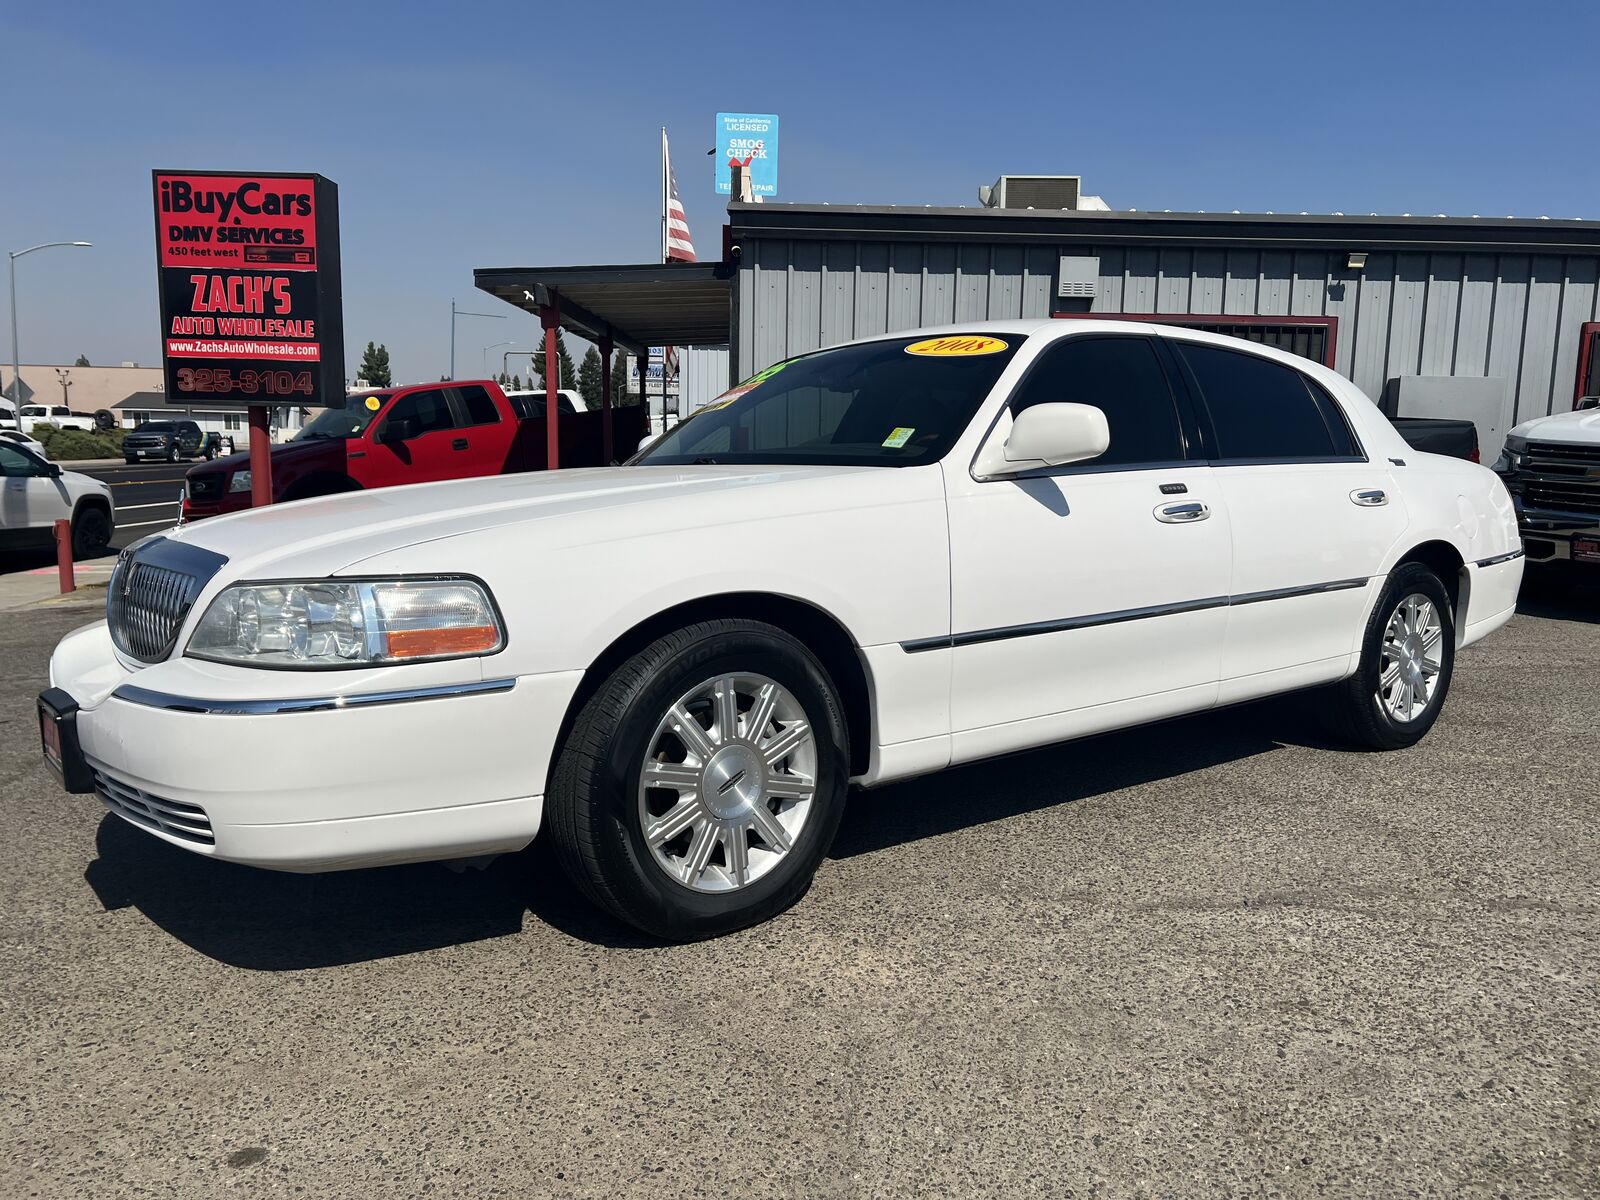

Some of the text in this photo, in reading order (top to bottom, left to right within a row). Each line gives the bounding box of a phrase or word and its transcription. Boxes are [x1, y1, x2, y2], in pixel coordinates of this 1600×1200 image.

[726, 123, 769, 132] LICENSED
[729, 139, 765, 149] SMOG
[726, 148, 768, 159] CHECK
[161, 180, 312, 223] iBuyCars
[168, 225, 305, 245] DMV SERVICES
[168, 246, 238, 257] 450 feet west
[190, 274, 292, 315] ZACH'S
[171, 316, 315, 338] AUTO WHOLESALE
[169, 341, 318, 355] www.ZachsAutoWholesale.com
[177, 367, 314, 395] 325-3104
